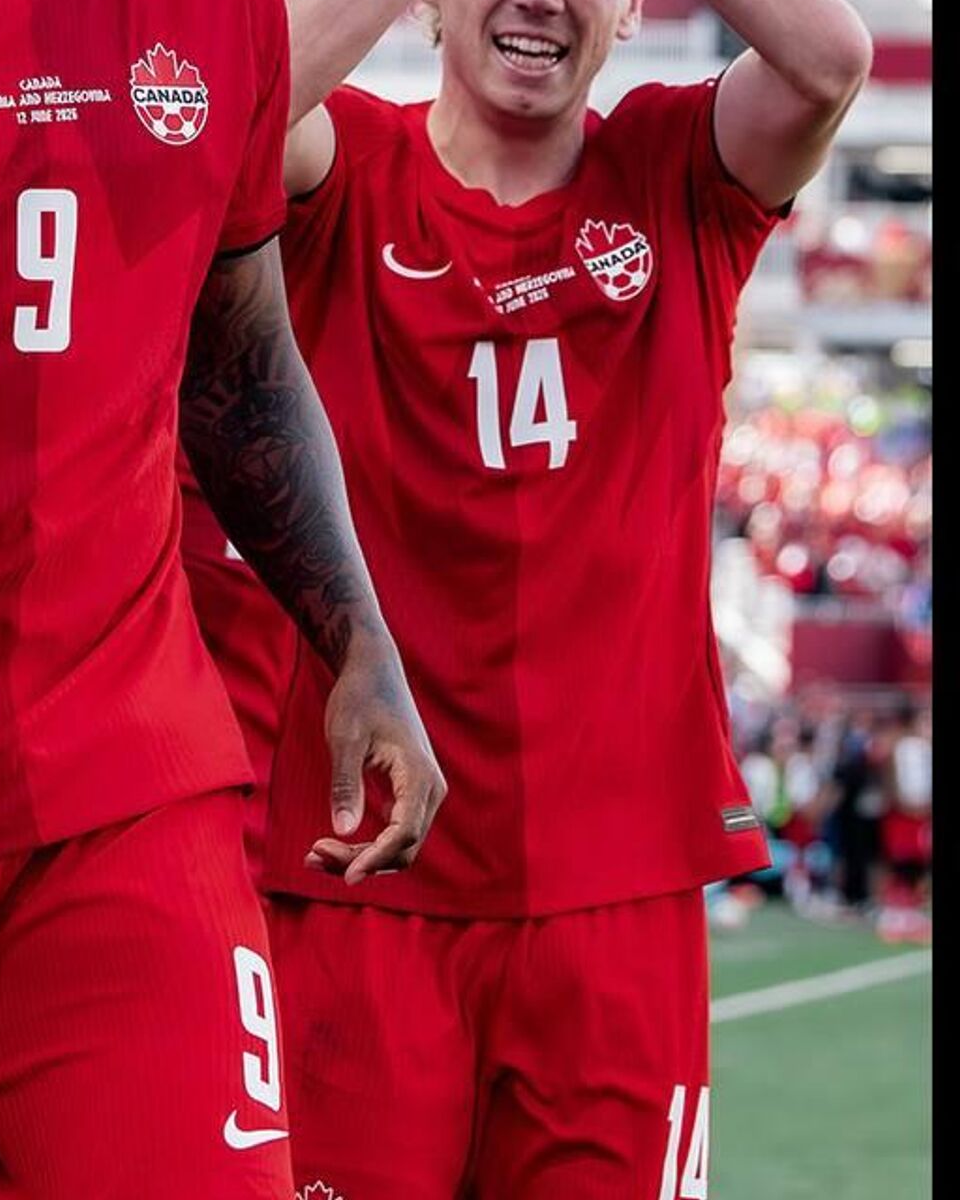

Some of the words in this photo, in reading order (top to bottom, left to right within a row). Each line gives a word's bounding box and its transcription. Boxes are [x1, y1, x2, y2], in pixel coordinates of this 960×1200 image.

[19, 76, 62, 91] CANADA
[19, 93, 41, 107] AND
[43, 89, 112, 106] HERZEGOVINA
[133, 87, 206, 105] CANADA
[13, 188, 78, 353] 9
[587, 240, 647, 272] ANADA
[467, 336, 577, 471] 14
[232, 944, 281, 1112] 9
[658, 1084, 710, 1200] 14
